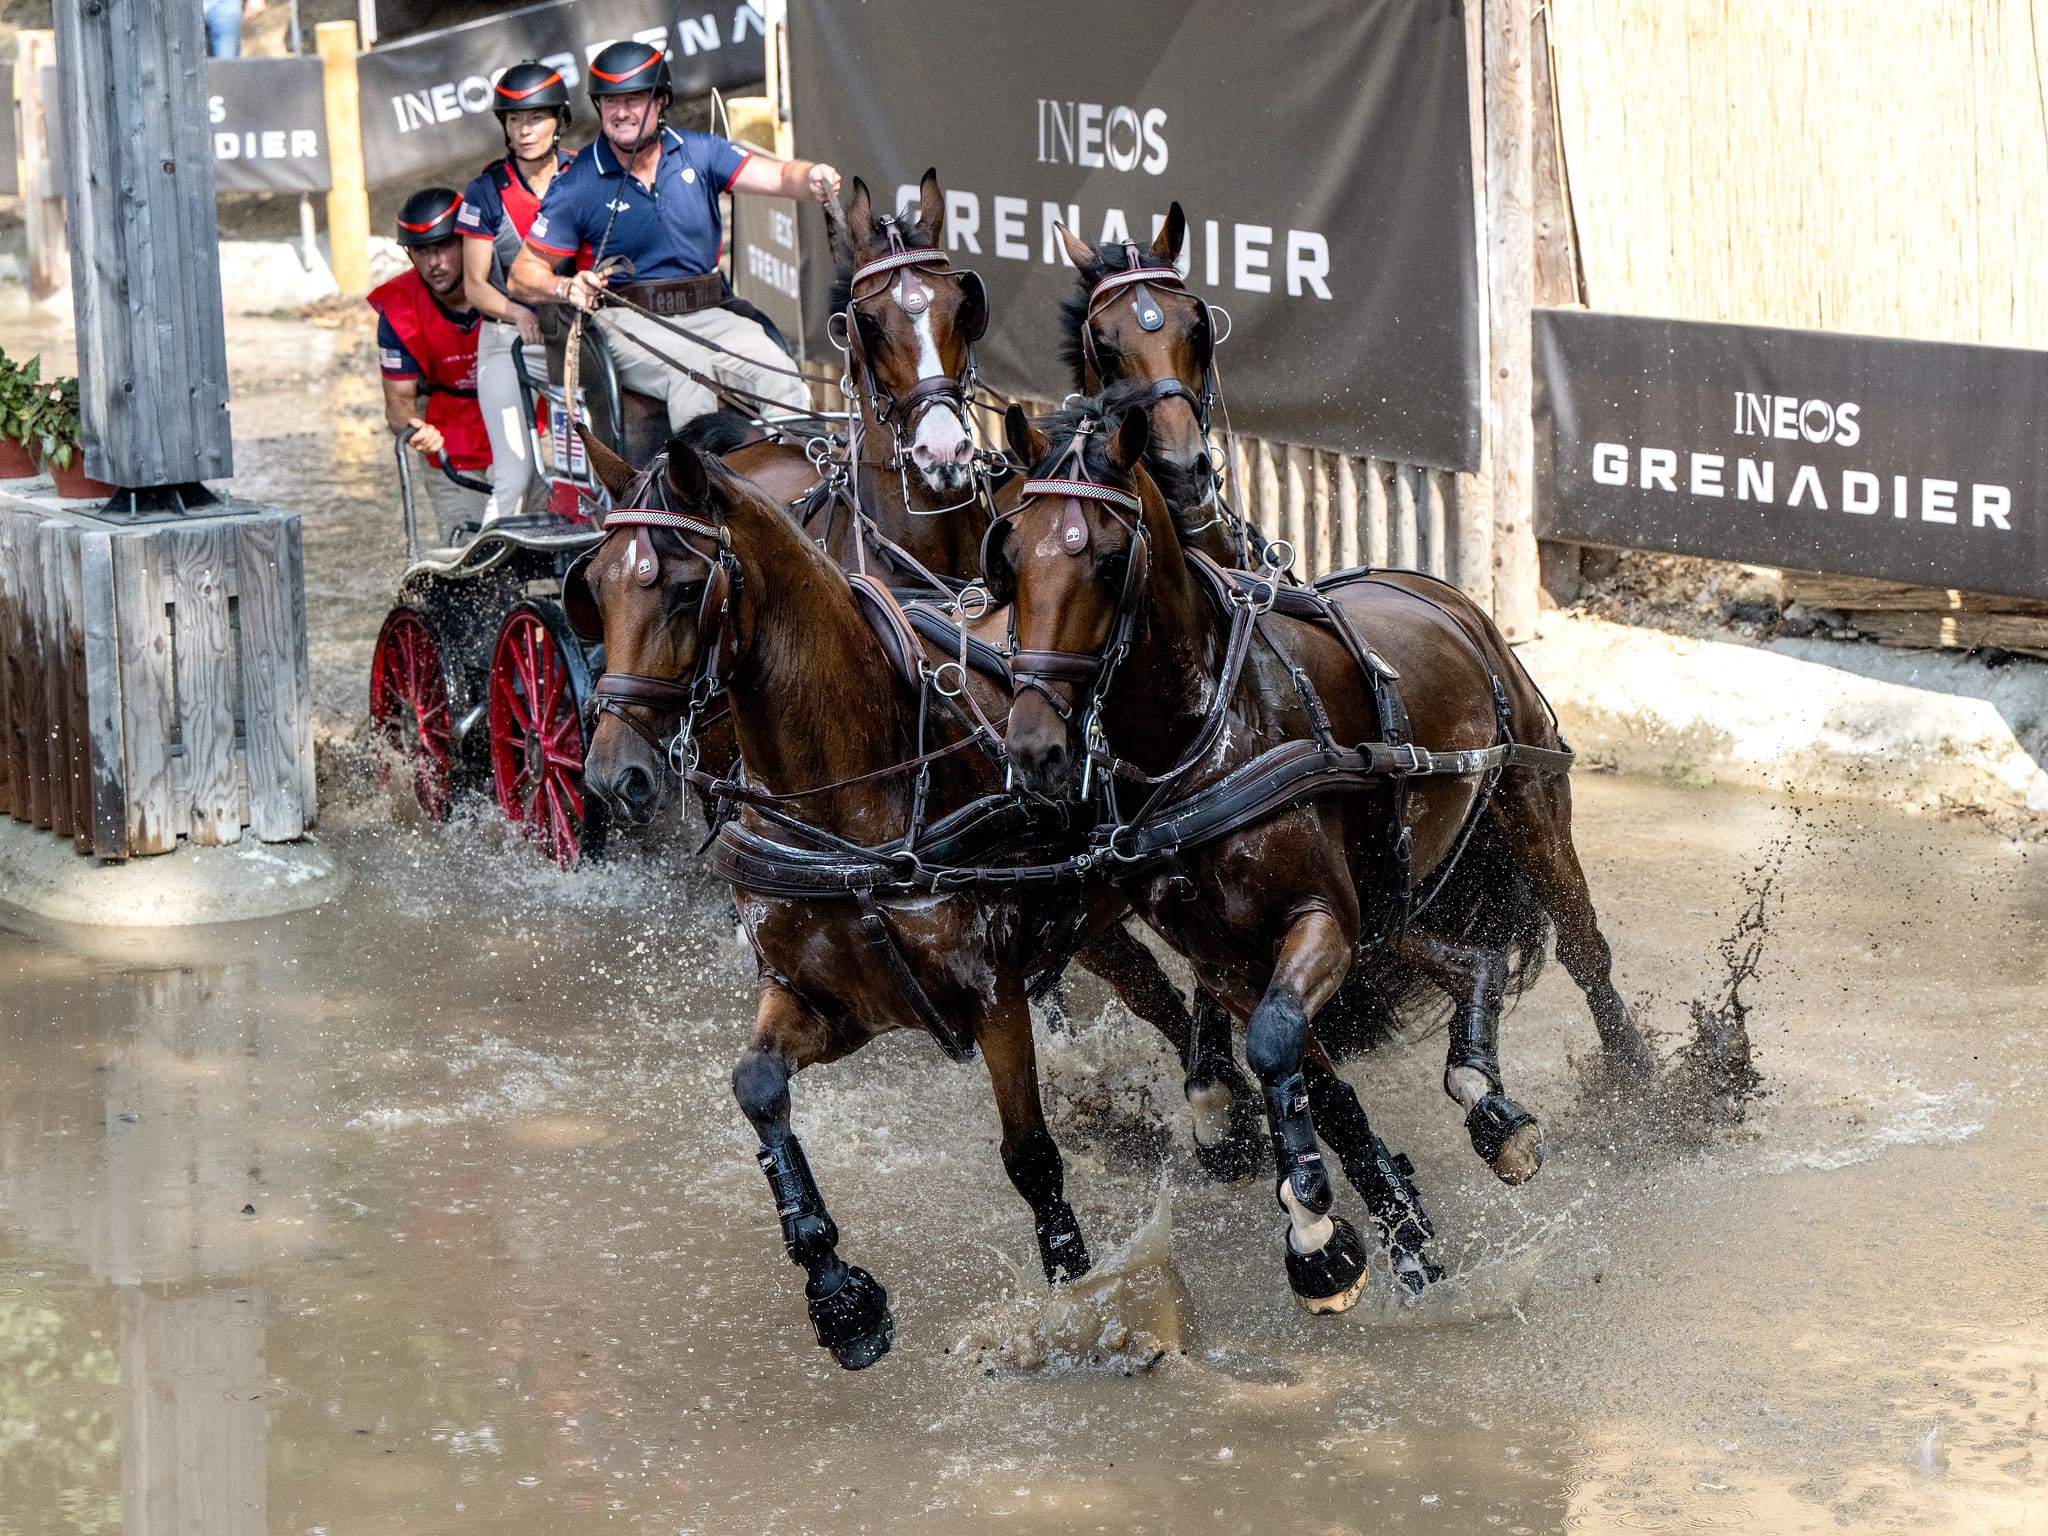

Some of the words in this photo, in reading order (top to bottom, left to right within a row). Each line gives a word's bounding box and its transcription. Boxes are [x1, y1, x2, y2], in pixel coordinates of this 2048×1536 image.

[1036, 98, 1169, 175] INEOS
[1733, 391, 1861, 447] INEOS
[1592, 442, 2012, 530] GRENADIER
